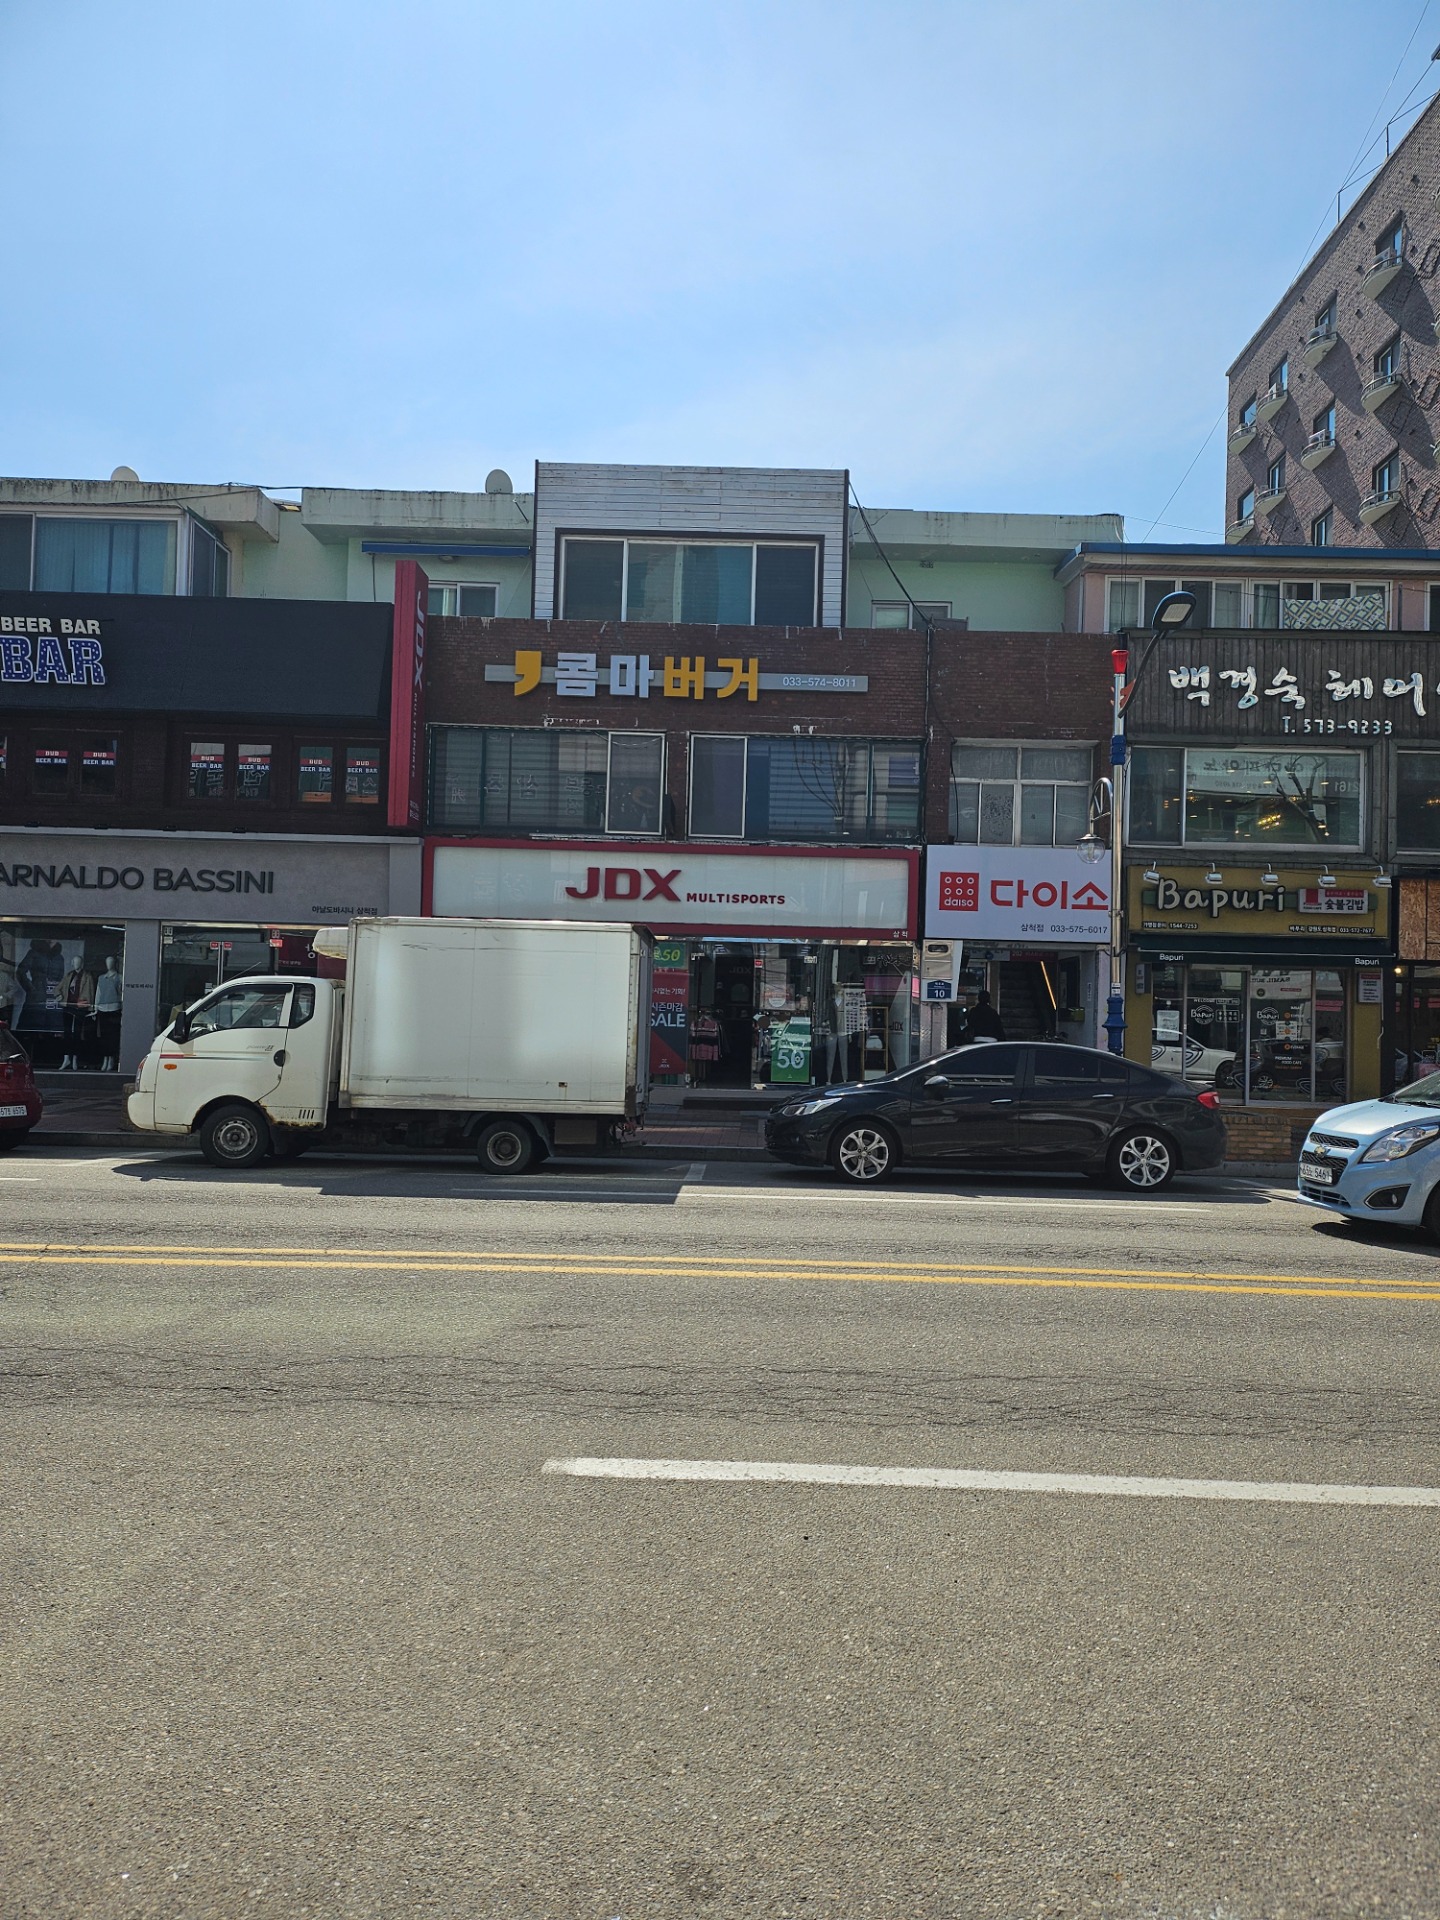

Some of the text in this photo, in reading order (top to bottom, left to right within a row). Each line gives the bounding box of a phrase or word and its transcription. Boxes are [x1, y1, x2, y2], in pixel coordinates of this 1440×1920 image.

[1, 616, 101, 634] BEER BAR
[782, 676, 856, 688] 033-574-8011
[1168, 665, 1306, 709] 백경숙
[1282, 716, 1393, 735] T. 573-9233
[153, 867, 274, 894] BASSINI
[565, 867, 786, 905] JDX MULTISPORTS
[990, 879, 1109, 911] 다이소
[1158, 878, 1285, 918] Bapuri
[944, 897, 974, 907] daiso
[1324, 898, 1365, 911] 숯불김밥
[356, 907, 378, 916] 삼척점
[1020, 923, 1108, 935] 삼척점 033-575-6017
[1159, 953, 1185, 962] Bapuri
[1354, 958, 1380, 966] Bapuri
[934, 990, 946, 998] 10
